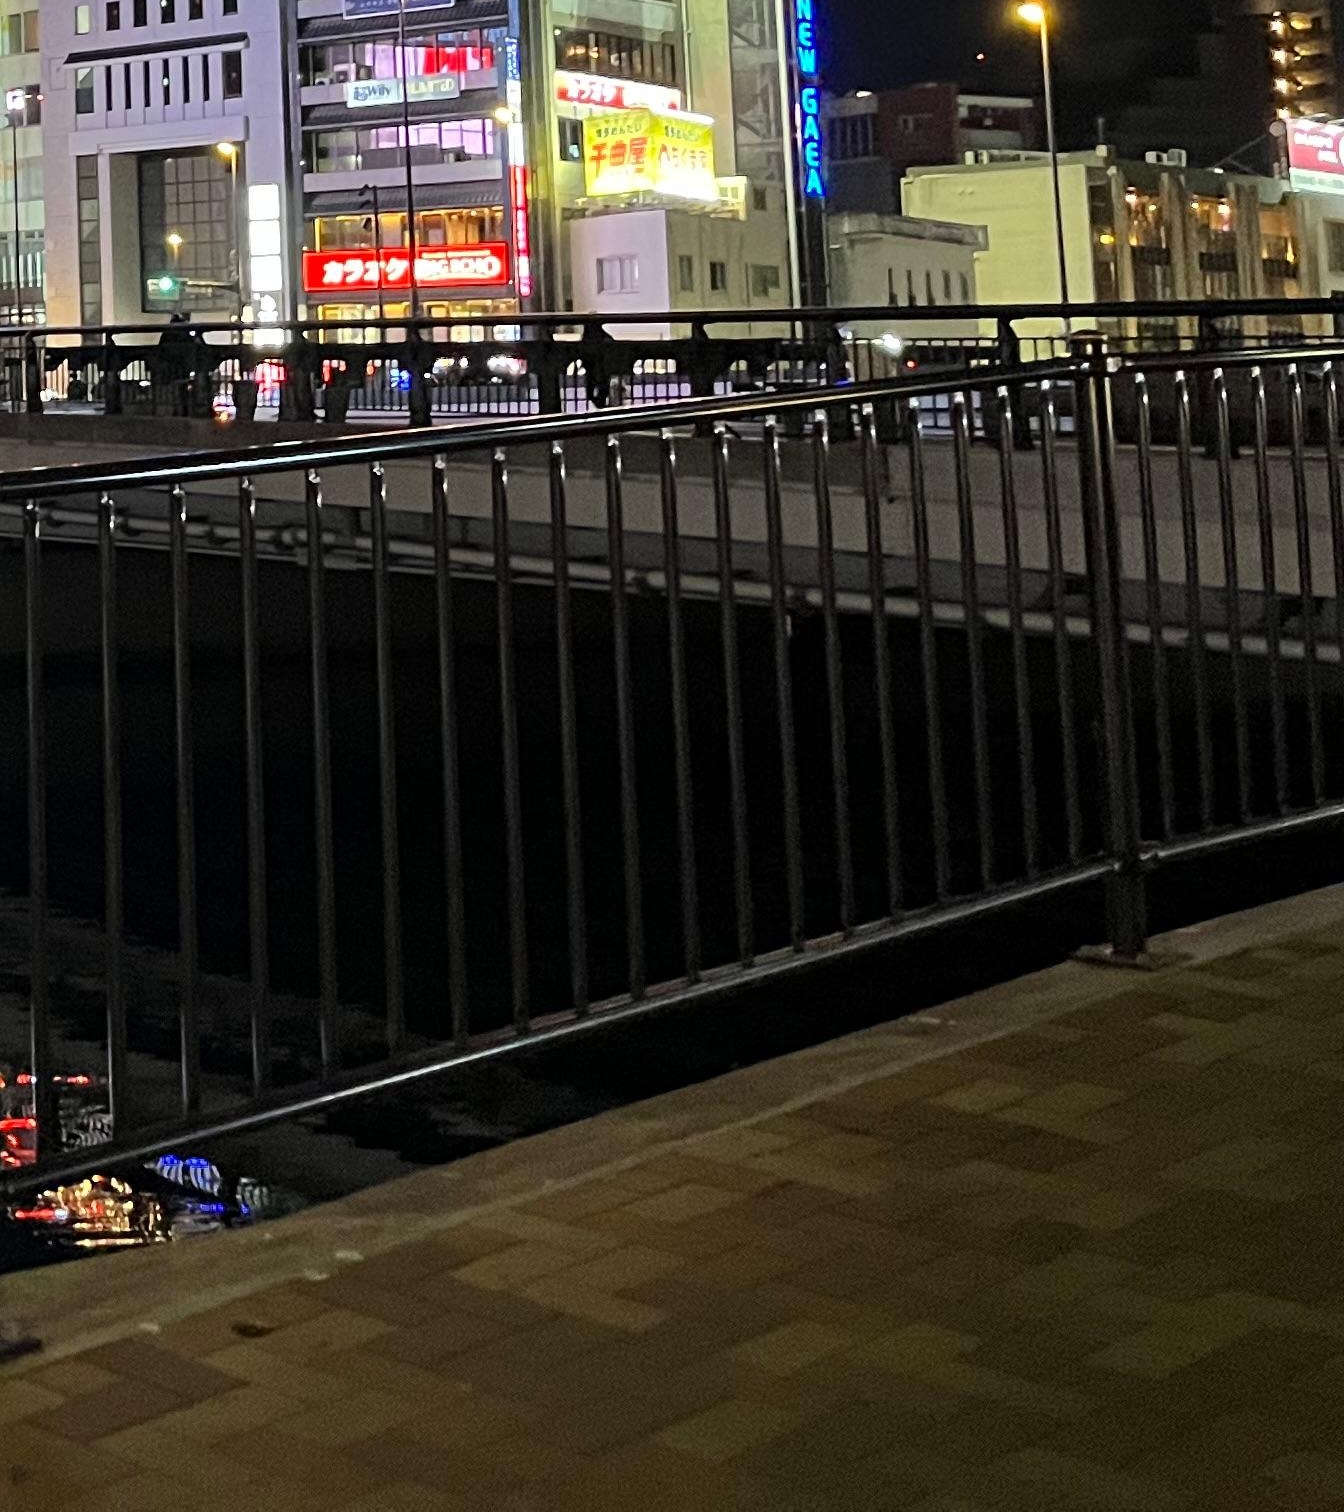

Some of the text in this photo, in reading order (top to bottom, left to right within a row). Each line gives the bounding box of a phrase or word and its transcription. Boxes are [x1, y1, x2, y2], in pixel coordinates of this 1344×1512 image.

[801, 88, 823, 194] GAEA
[322, 257, 410, 284] カラオケ
